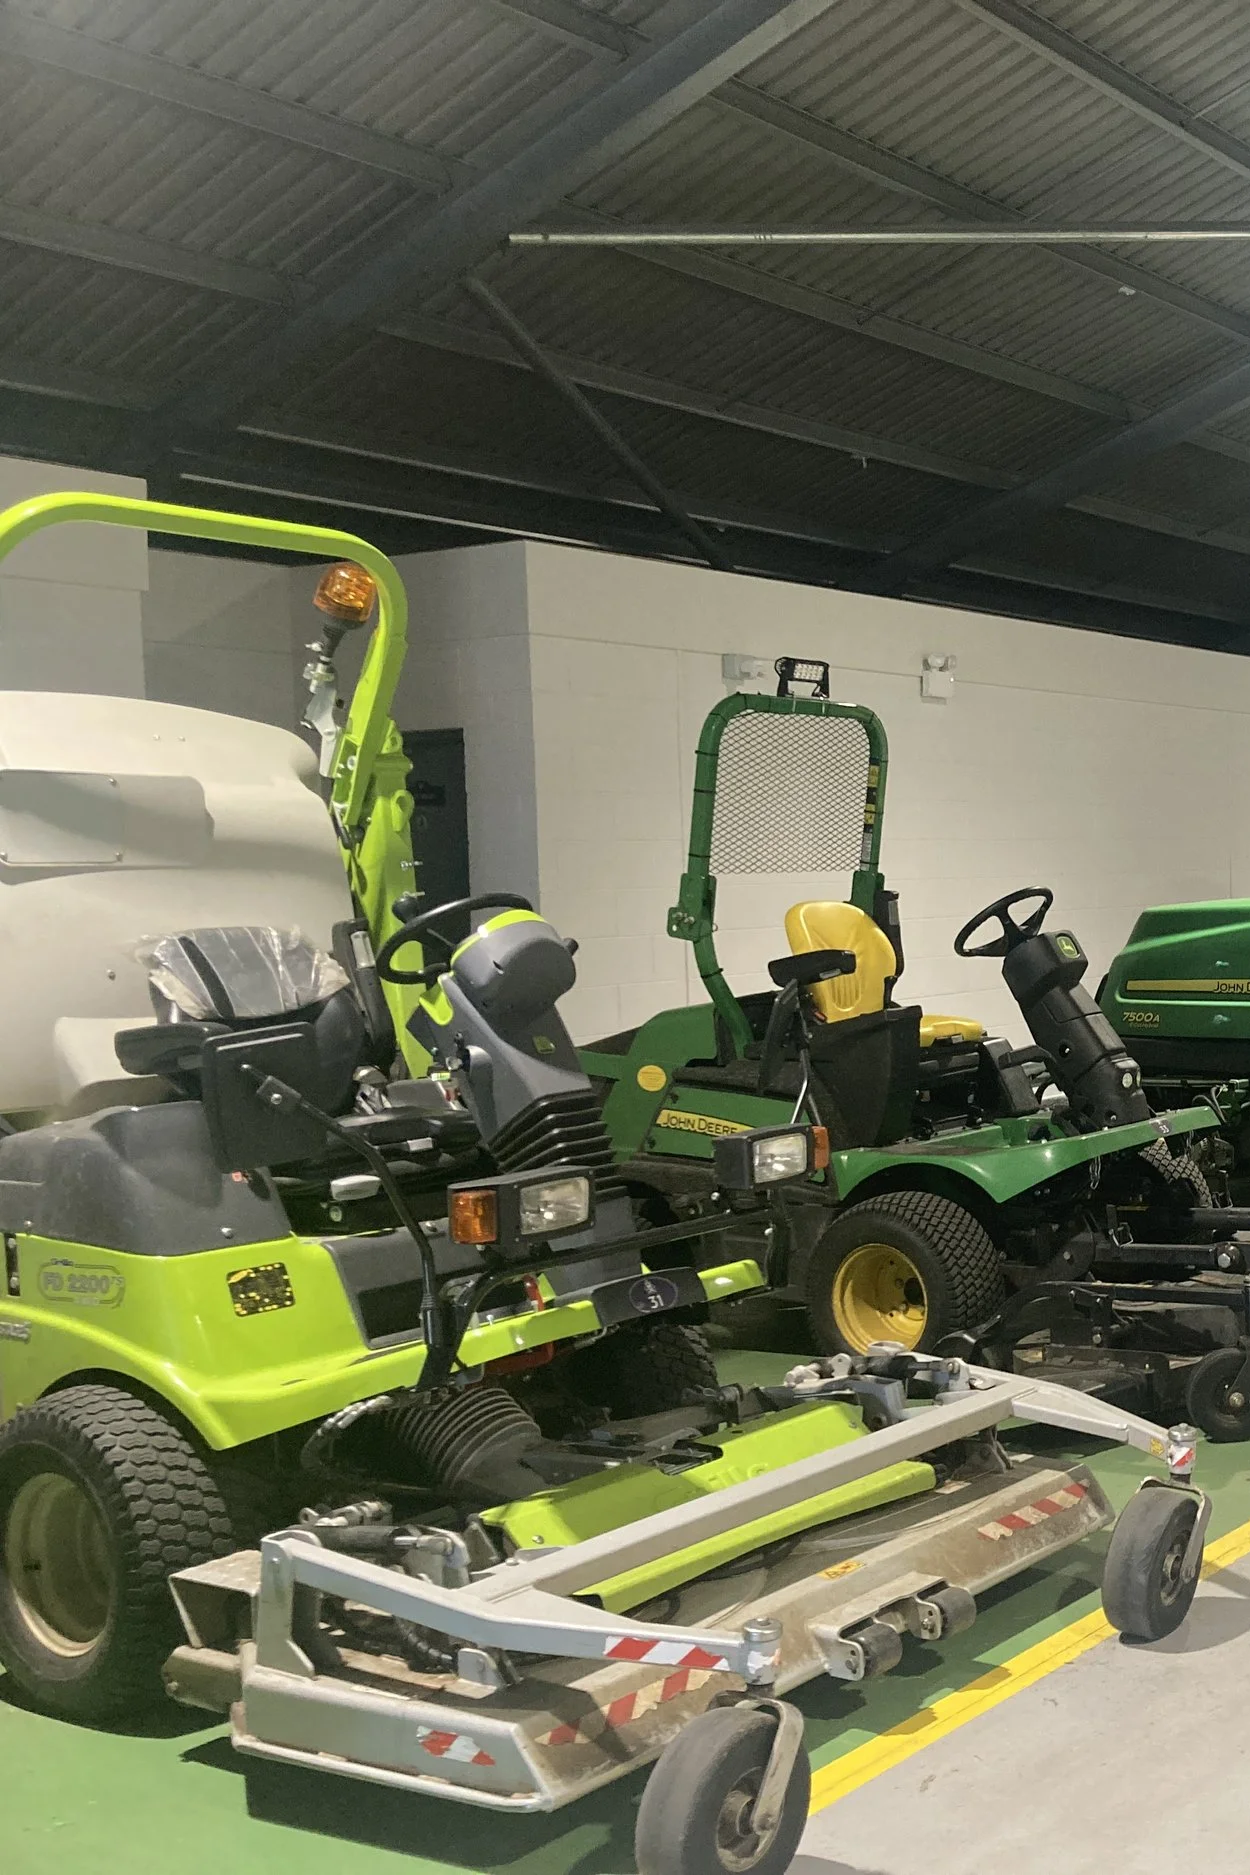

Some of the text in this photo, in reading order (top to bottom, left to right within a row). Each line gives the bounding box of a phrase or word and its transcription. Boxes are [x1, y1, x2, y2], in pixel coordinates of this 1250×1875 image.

[1214, 981, 1244, 993] JOHN
[1122, 1011, 1161, 1023] 7500A
[662, 1112, 738, 1137] JOHN DEERE
[647, 1294, 664, 1309] 31
